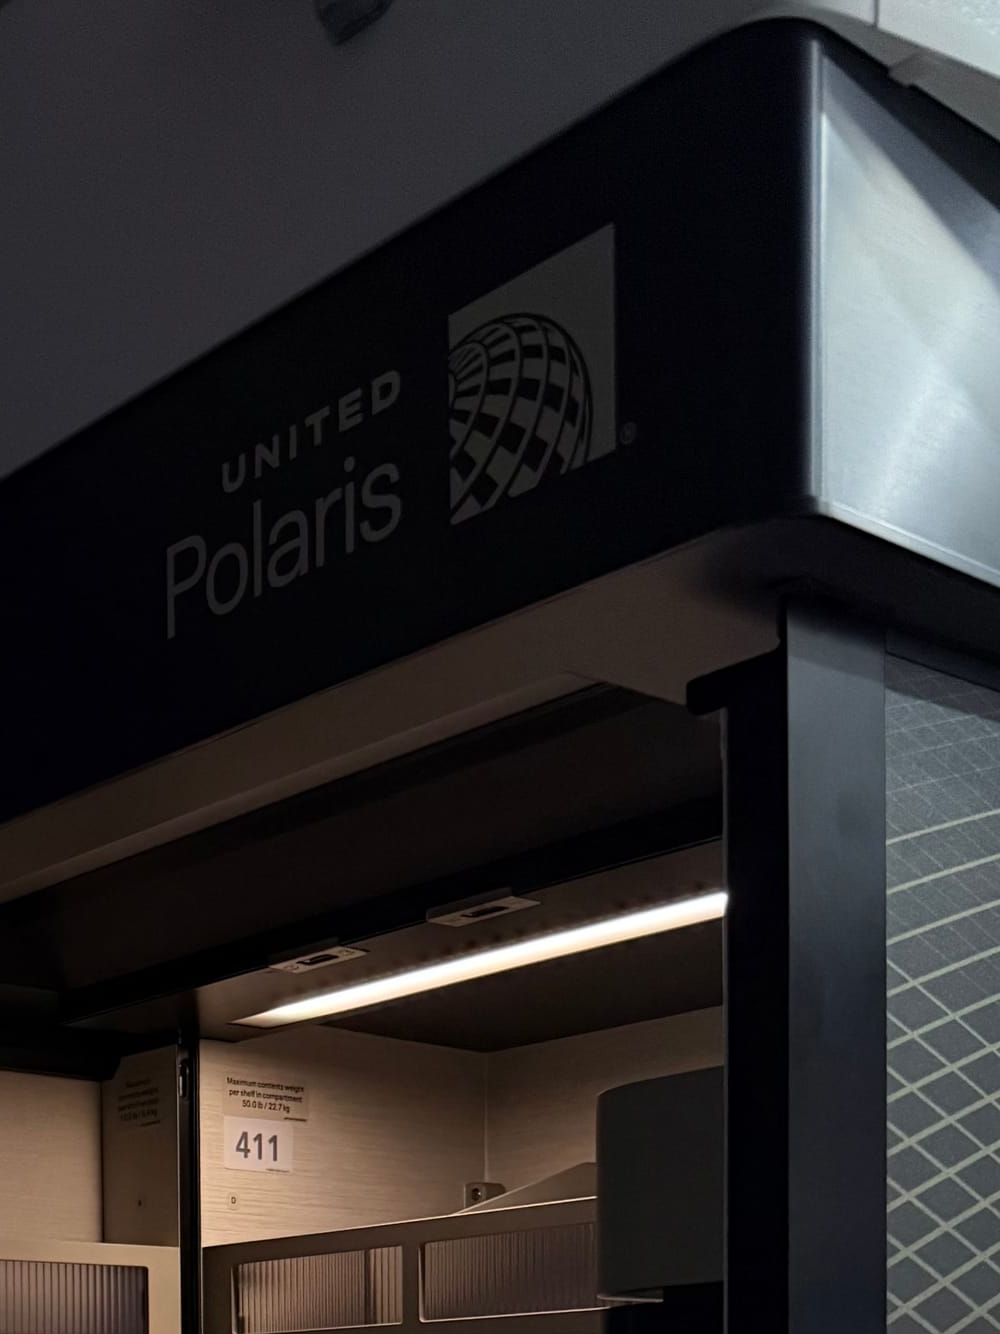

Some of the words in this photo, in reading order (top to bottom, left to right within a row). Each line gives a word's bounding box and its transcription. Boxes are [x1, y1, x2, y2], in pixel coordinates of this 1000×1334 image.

[221, 369, 401, 494] UNITED
[166, 456, 402, 641] Polaris
[226, 1076, 256, 1087] Maximum
[257, 1082, 283, 1090] contents
[284, 1085, 304, 1094] weight
[228, 1089, 239, 1097] per
[240, 1089, 255, 1098] shelf
[262, 1093, 302, 1103] compartment
[242, 1099, 257, 1109] 50.0
[268, 1102, 282, 1112] 22.7
[283, 1104, 290, 1114] kg
[235, 1131, 278, 1162] 411
